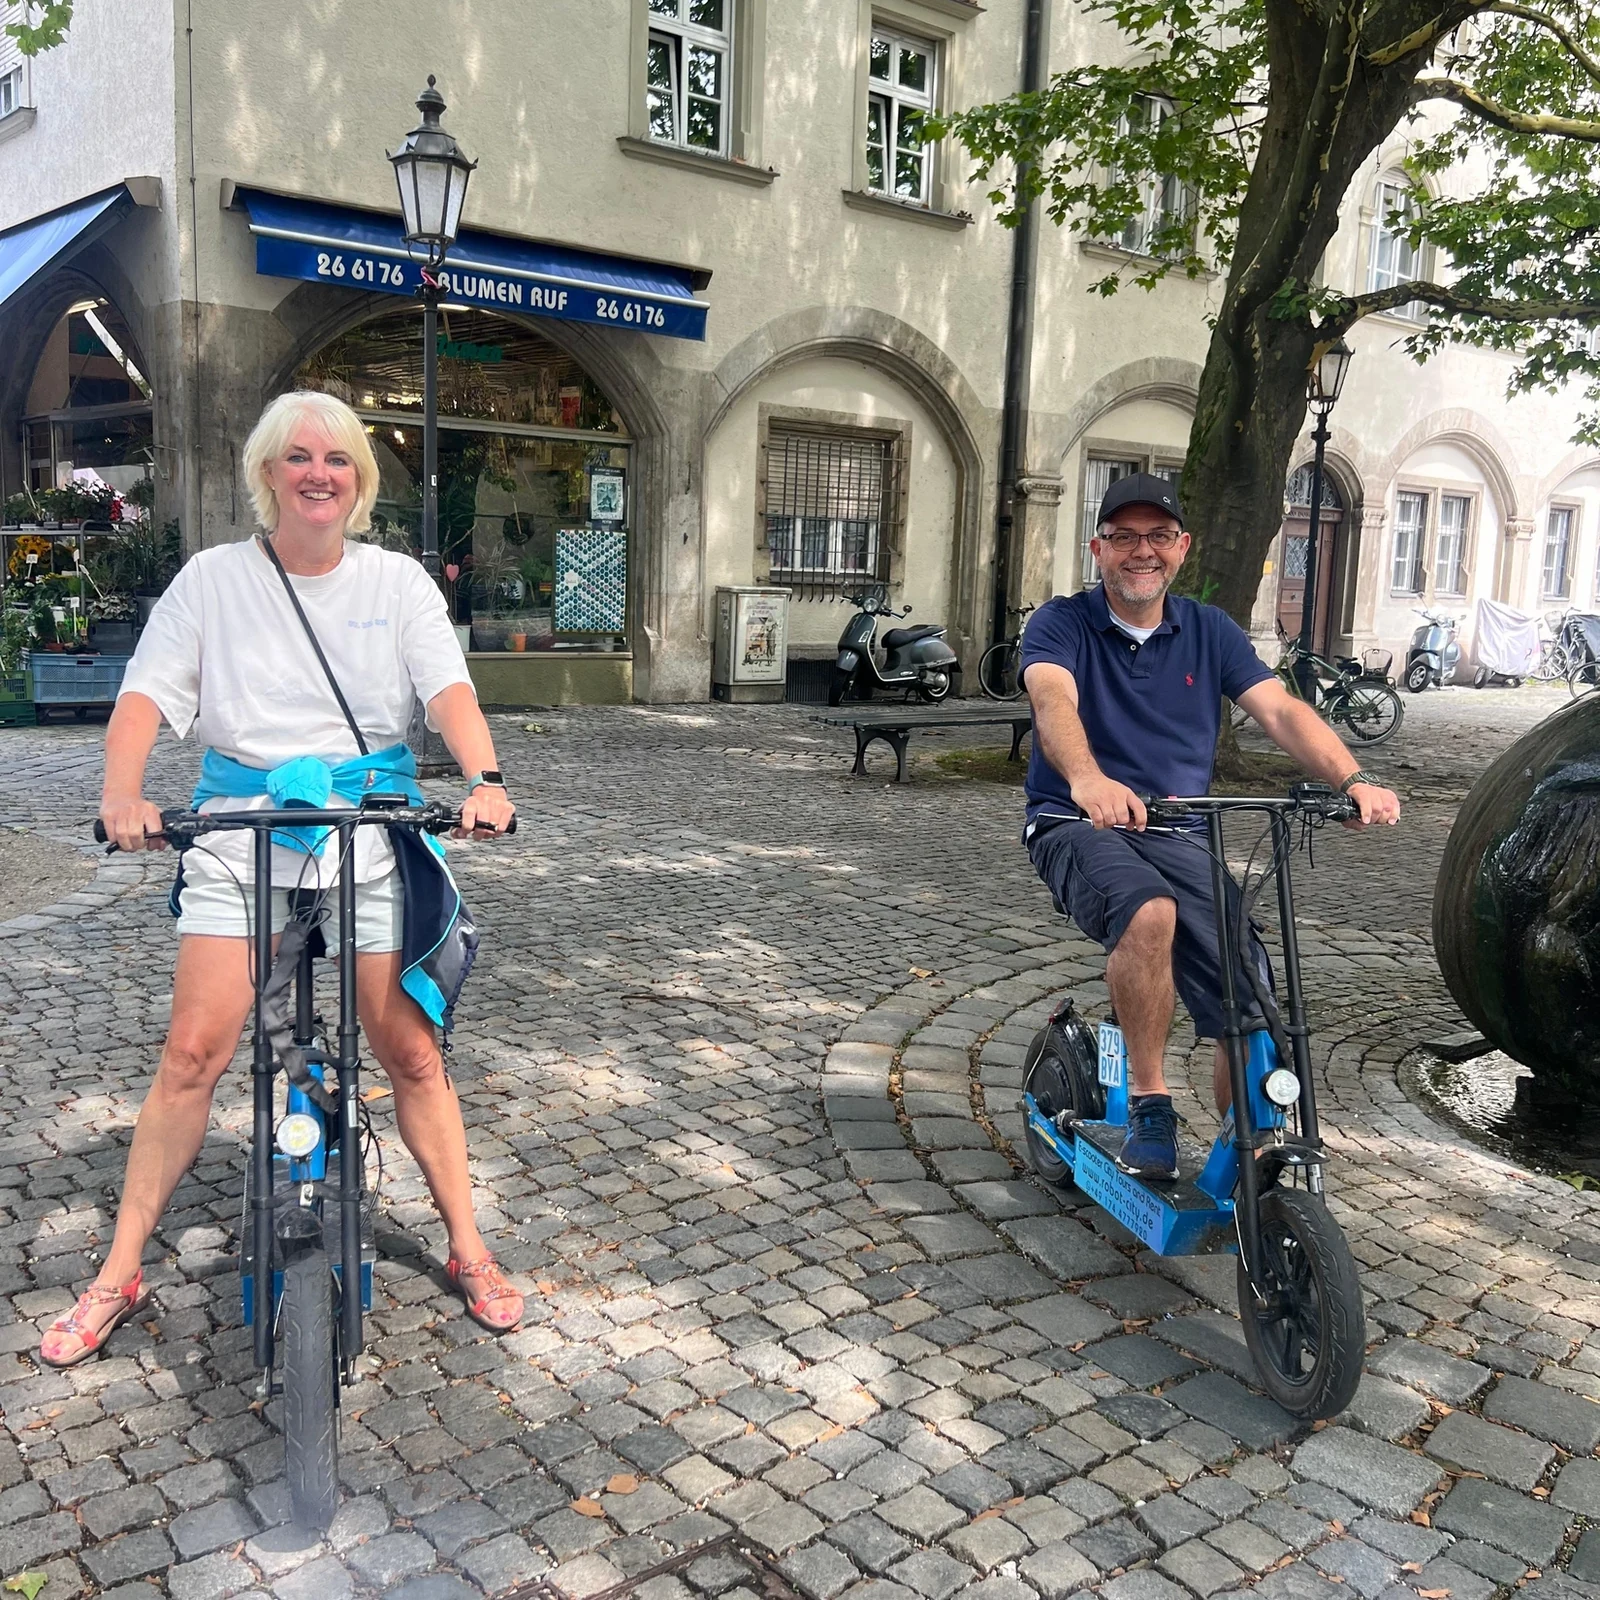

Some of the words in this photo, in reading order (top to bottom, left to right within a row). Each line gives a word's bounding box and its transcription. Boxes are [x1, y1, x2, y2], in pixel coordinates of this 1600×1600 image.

[438, 271, 522, 304] BLUMEN
[530, 286, 568, 311] RUF
[1101, 1028, 1119, 1055] 379
[1101, 1055, 1119, 1084] BYA
[1082, 1163, 1154, 1230] www.robot-city.de
[1103, 1161, 1115, 1181] City
[1115, 1170, 1132, 1193] Tours
[1132, 1187, 1146, 1204] and
[1145, 1195, 1162, 1218] Rent
[1104, 1196, 1116, 1213] 174
